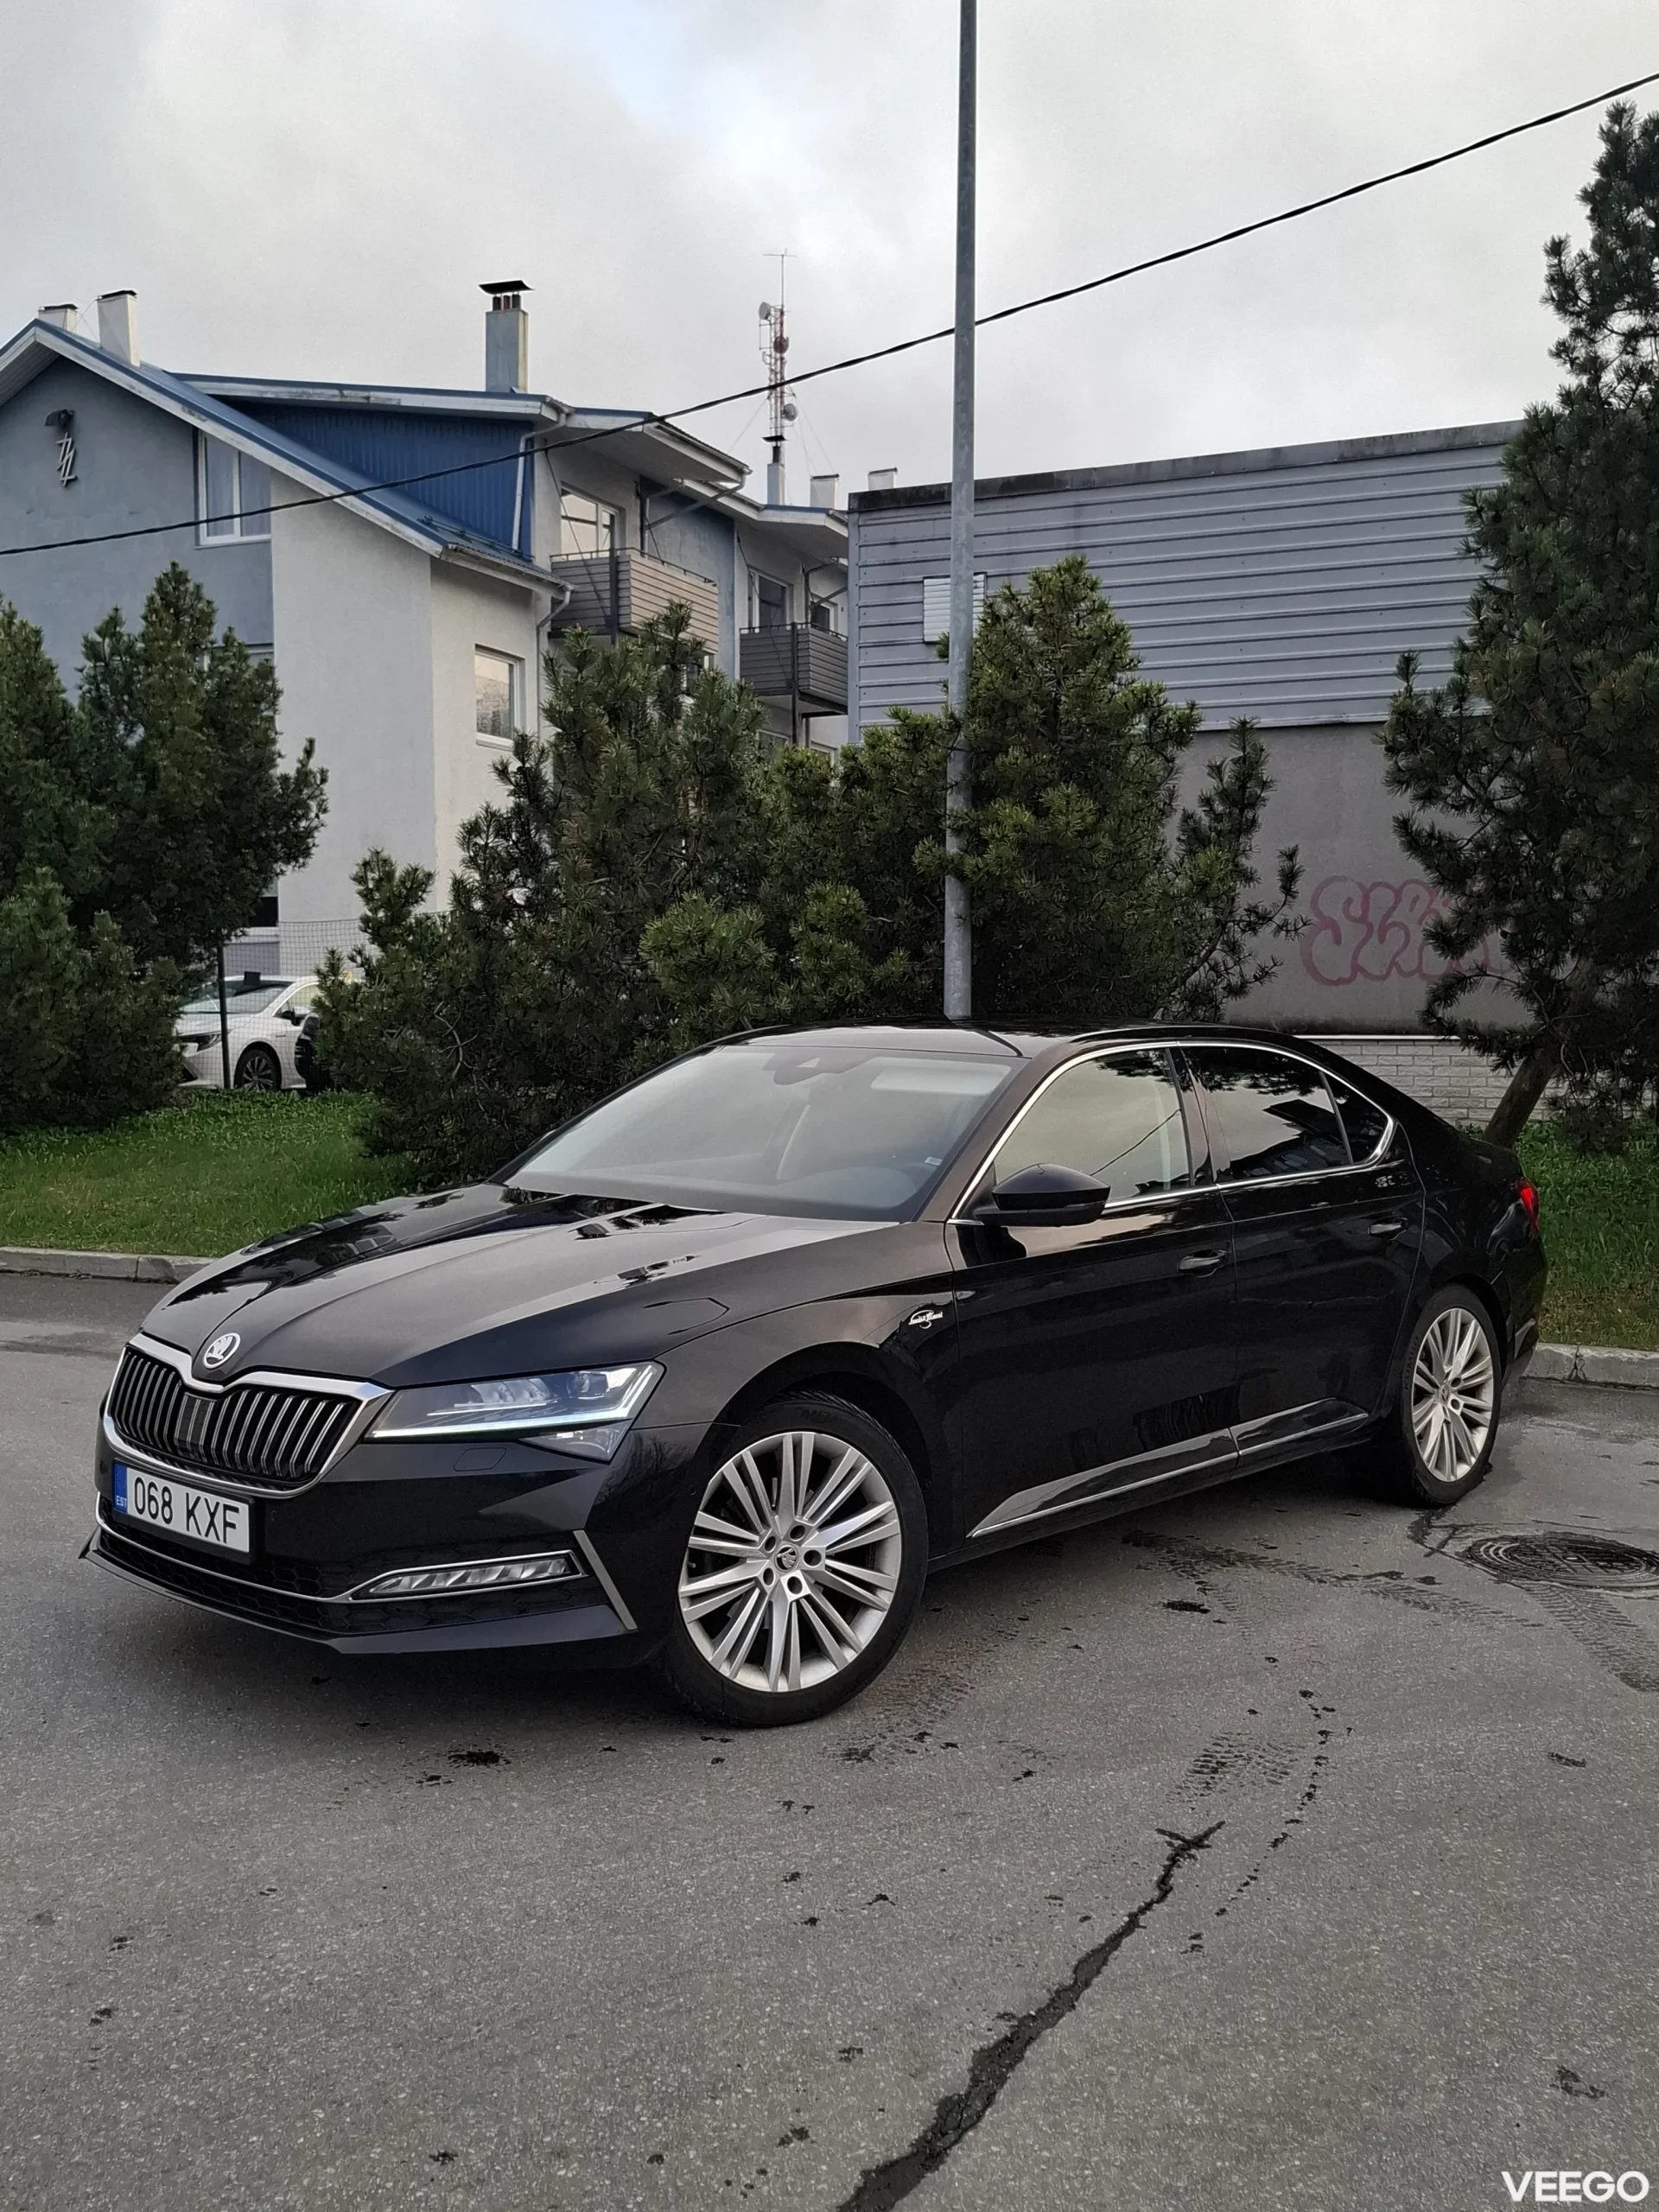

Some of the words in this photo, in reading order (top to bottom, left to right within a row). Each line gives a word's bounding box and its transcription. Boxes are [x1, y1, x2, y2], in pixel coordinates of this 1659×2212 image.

[116, 1495, 128, 1509] EST
[134, 1476, 173, 1524] 068
[186, 1492, 239, 1543] KXF
